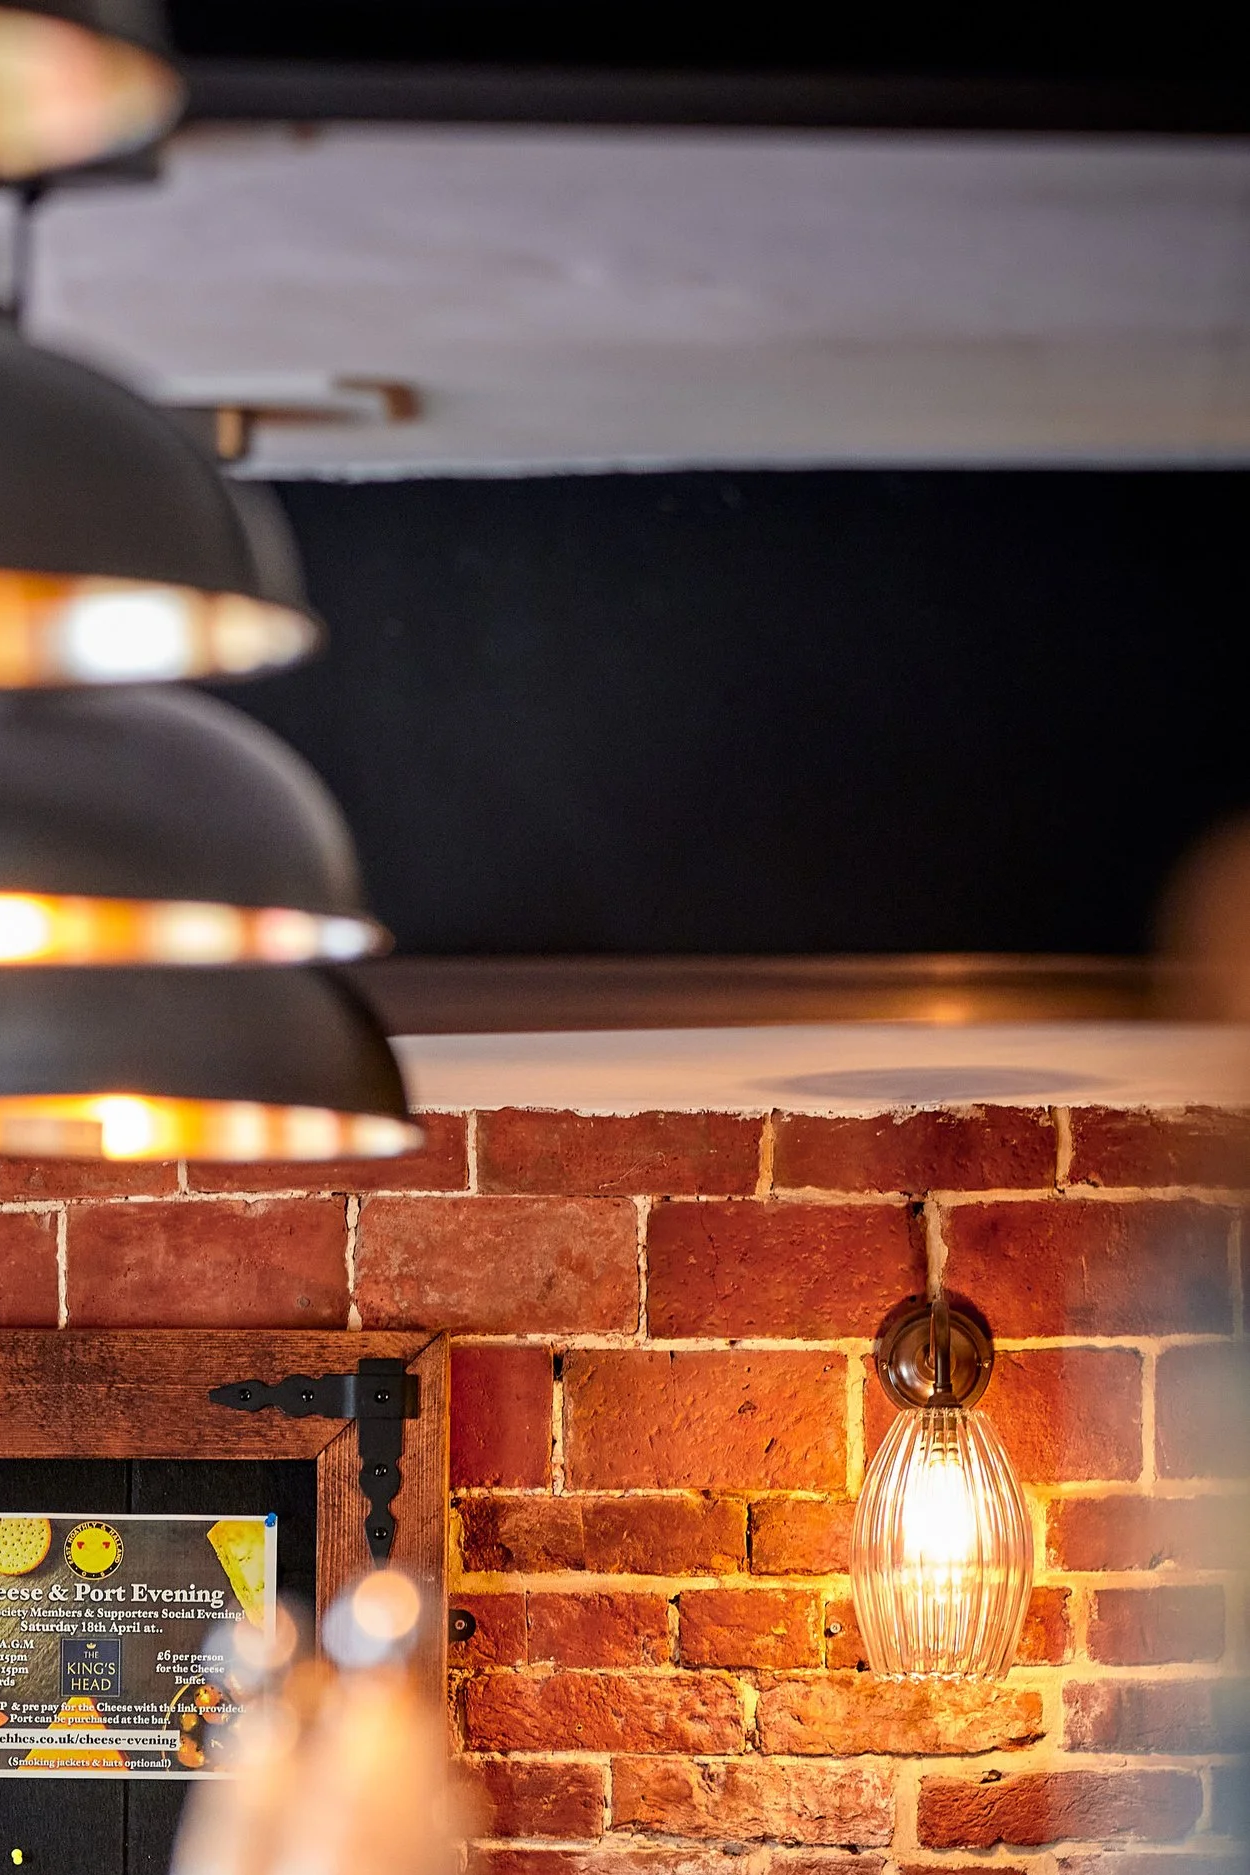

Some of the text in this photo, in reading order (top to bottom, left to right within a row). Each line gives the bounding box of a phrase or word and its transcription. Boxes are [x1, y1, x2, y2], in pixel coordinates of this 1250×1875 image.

[48, 1584, 69, 1601] &
[74, 1583, 125, 1602] Port
[131, 1583, 224, 1608] Evening
[30, 1608, 82, 1618] Members
[84, 1609, 94, 1618] &
[97, 1608, 158, 1620] Supporters
[162, 1609, 195, 1619] Social
[197, 1609, 245, 1621] Evening!
[20, 1621, 163, 1635] Saturday 18th April at..
[0, 1639, 34, 1649] A.G.M
[83, 1651, 99, 1659] THE
[157, 1650, 224, 1663] £6 per person
[67, 1662, 116, 1674] KING'S
[156, 1664, 225, 1673] for the Cheese
[71, 1678, 111, 1691] HEAD
[175, 1676, 206, 1684] Buffet
[11, 1702, 20, 1711] &
[22, 1704, 39, 1713] pre
[41, 1704, 59, 1713] pay
[60, 1703, 77, 1711] for
[78, 1703, 94, 1712] the
[97, 1703, 132, 1712] Cheese
[134, 1703, 158, 1712] with
[159, 1704, 176, 1712] the
[177, 1704, 196, 1713] link
[198, 1704, 247, 1714] provided.
[10, 1713, 33, 1722] Port
[54, 1714, 65, 1723] be
[68, 1715, 119, 1725] purchased
[133, 1715, 149, 1724] the
[151, 1715, 170, 1724] bar.
[0, 1733, 177, 1748] ehhcs.co.uk/cheese-evening
[8, 1757, 172, 1768] (Smoking jackets & hats optional!)
